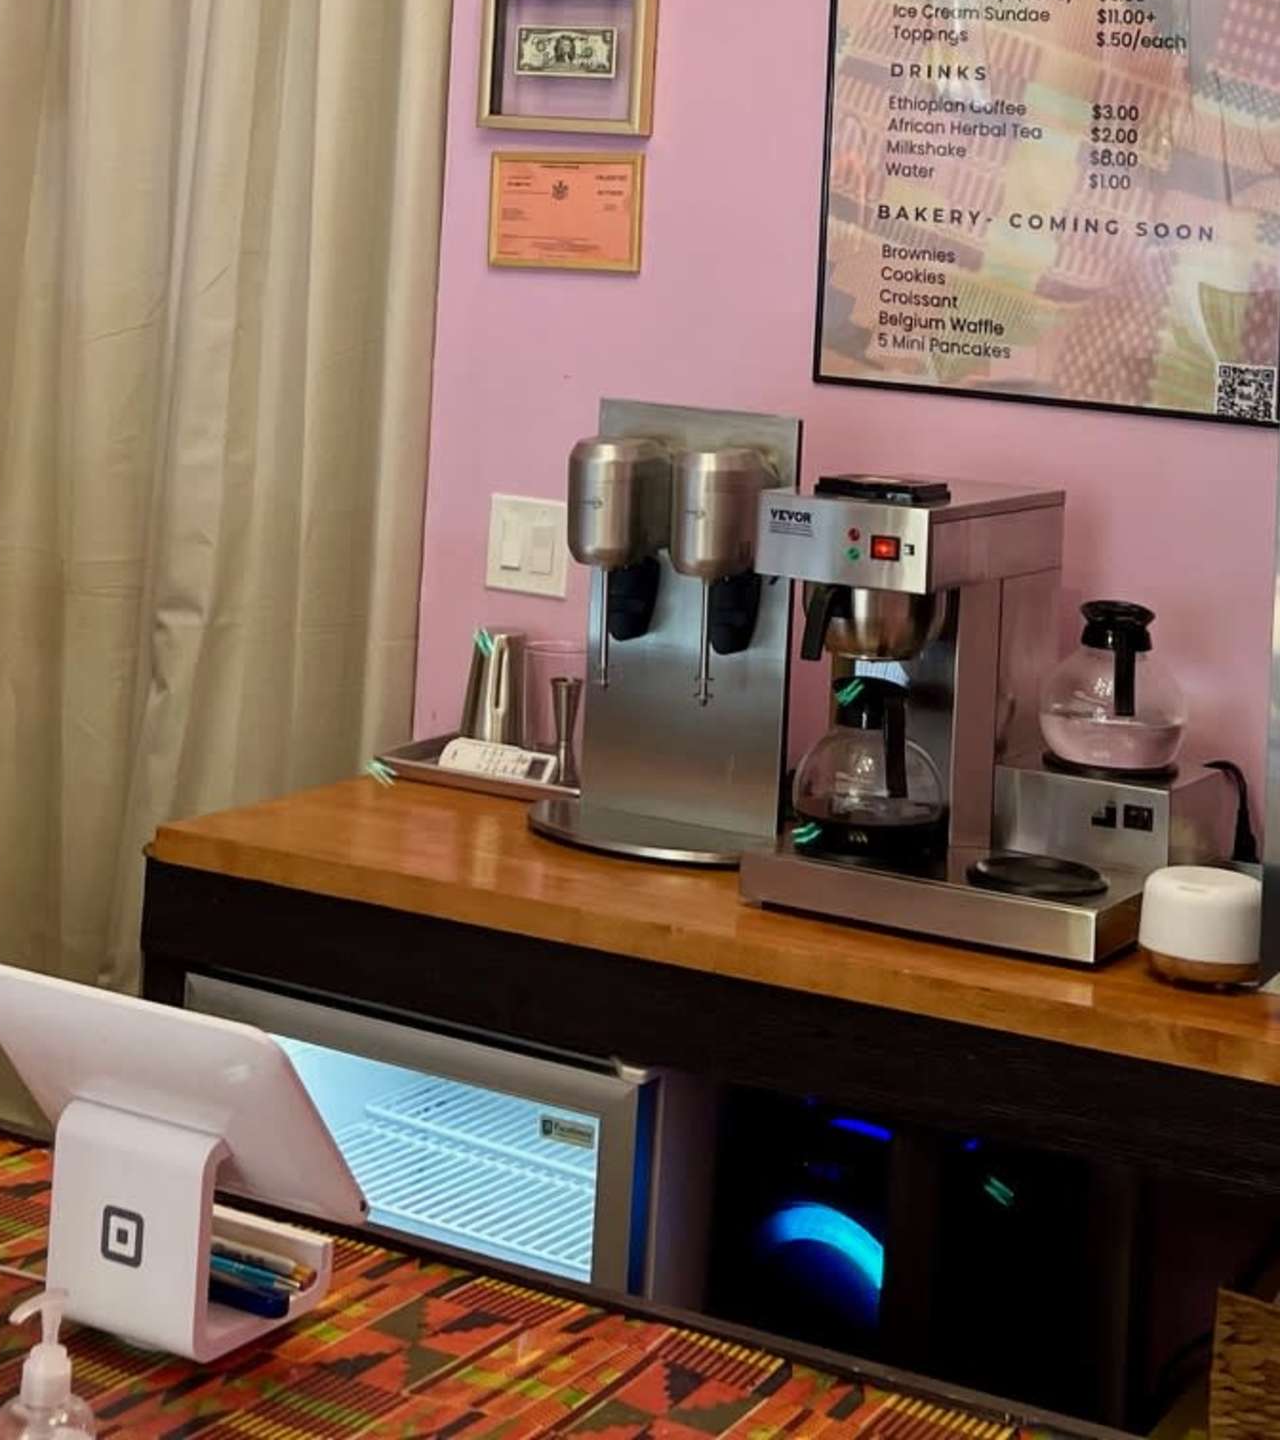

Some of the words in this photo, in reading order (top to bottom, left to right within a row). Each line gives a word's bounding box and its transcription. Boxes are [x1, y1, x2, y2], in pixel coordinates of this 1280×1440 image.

[893, 5, 917, 20] Ice
[921, 6, 980, 21] Cream
[984, 7, 1050, 23] Sundae
[1097, 9, 1156, 25] $11.00+
[892, 26, 968, 44] Toppings
[1096, 31, 1186, 50] $.50/each
[891, 64, 987, 81] DRINKS
[889, 96, 965, 116] Ethiopian
[969, 100, 1027, 117] Coffee
[1092, 105, 1139, 122] $3.00
[887, 118, 946, 135] African
[950, 121, 1006, 137] Herbal
[1010, 124, 1042, 140] Tea
[1091, 128, 1138, 145] $2.00
[886, 140, 967, 158] Milkshake
[1090, 151, 1138, 168] $8.00
[885, 163, 934, 179] Water
[1089, 174, 1130, 191] $1.00
[878, 205, 994, 226] BAKERY-
[1009, 213, 1121, 236] COMING
[1136, 222, 1215, 241] SOON
[882, 245, 956, 264] Brownies
[881, 267, 946, 285] Cookies
[879, 289, 959, 309] Croissant
[879, 311, 946, 334] Belgium
[950, 316, 1005, 336] Waffle
[878, 335, 888, 349] 5
[892, 335, 926, 351] Mini
[930, 338, 1011, 359] Pancakes
[771, 509, 812, 524] VEVOR
